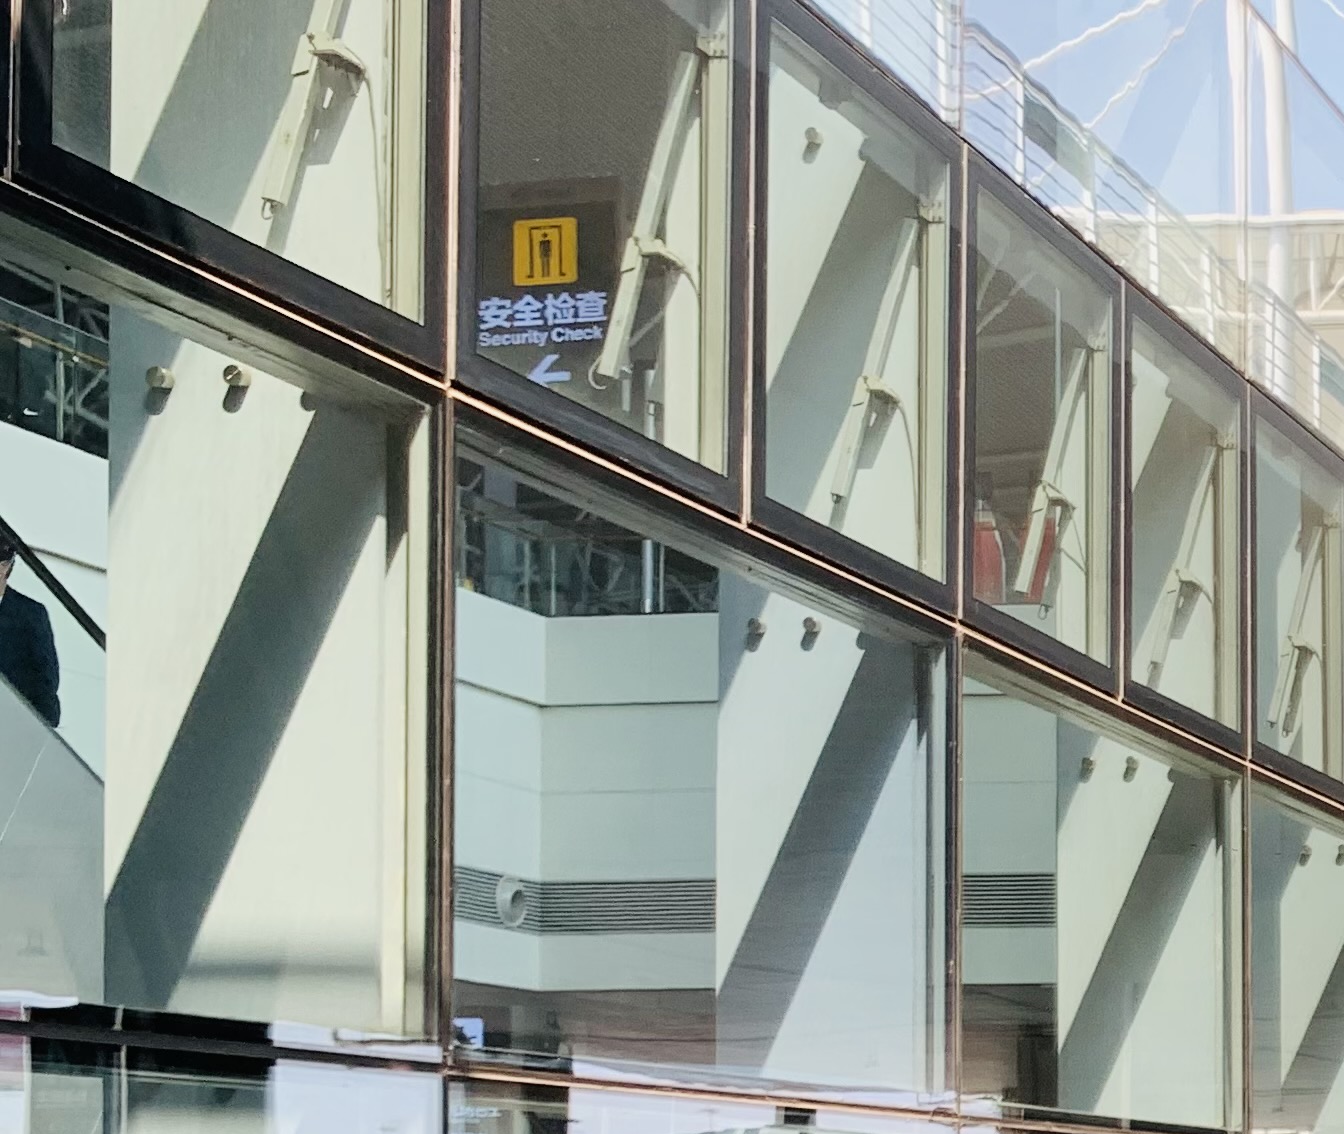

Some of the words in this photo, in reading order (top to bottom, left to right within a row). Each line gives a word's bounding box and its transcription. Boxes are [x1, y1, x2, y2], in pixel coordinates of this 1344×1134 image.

[478, 290, 607, 329] 安全检查
[479, 330, 548, 347] Security
[551, 326, 603, 342] Check
